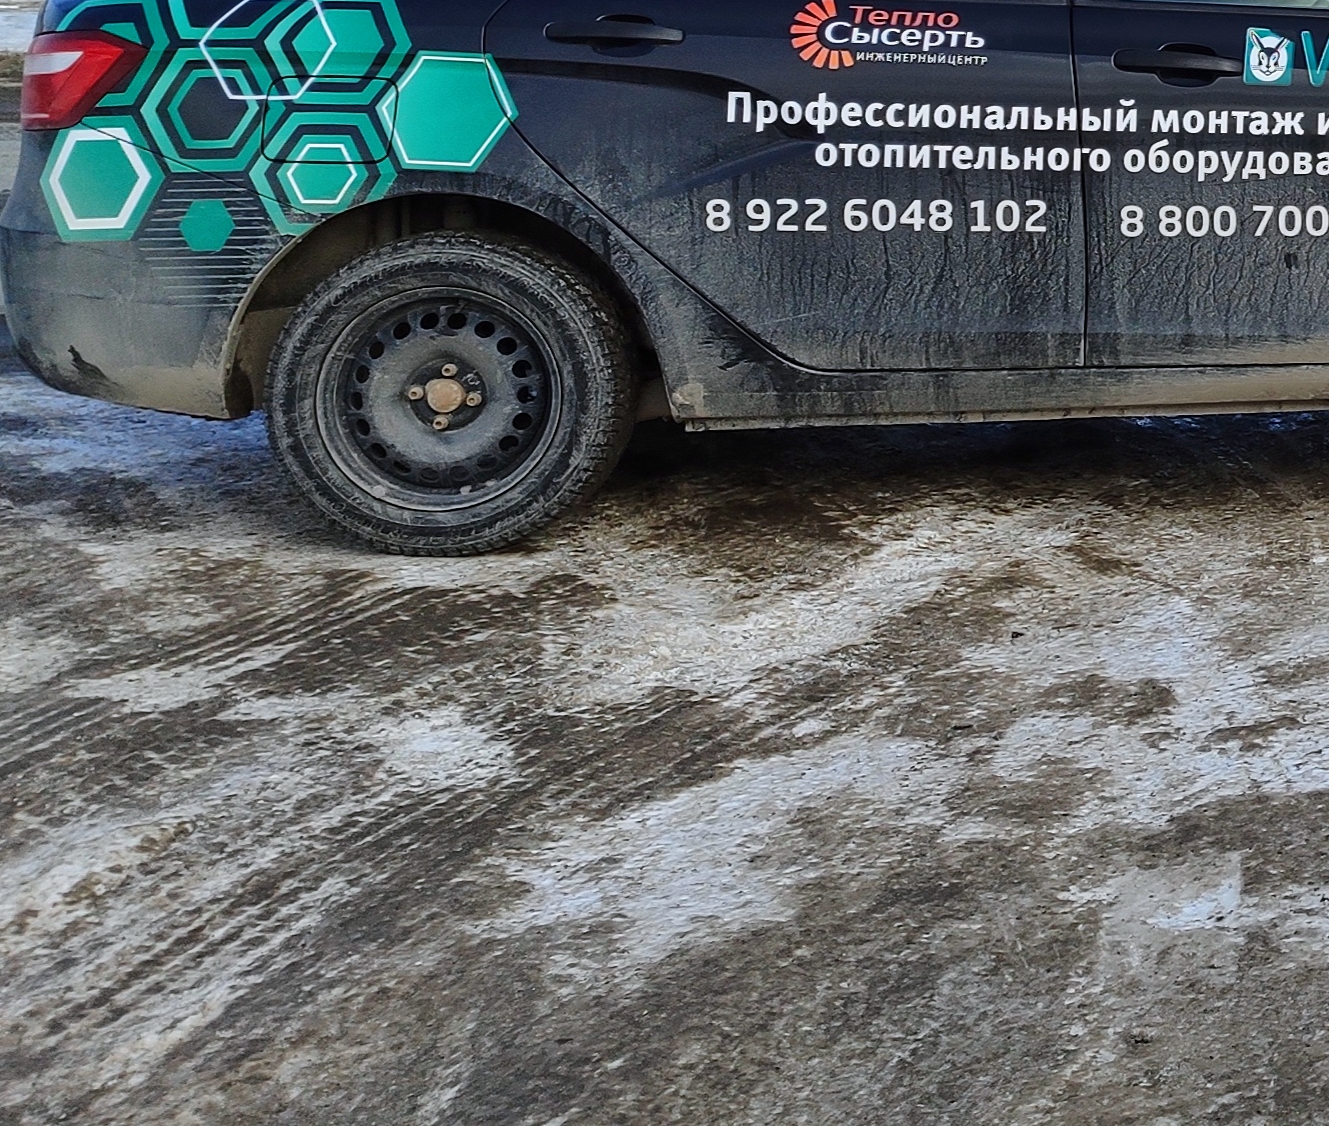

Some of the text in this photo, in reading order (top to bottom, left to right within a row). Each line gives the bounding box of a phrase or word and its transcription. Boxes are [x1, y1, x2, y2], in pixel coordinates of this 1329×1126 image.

[849, 5, 960, 28] Тепло
[824, 21, 985, 51] Сысерть
[726, 91, 1138, 134] Профессиональный
[1150, 109, 1305, 136] монтаж
[814, 142, 1112, 172] отопительного
[705, 198, 1047, 233] 8 922 6048 102
[1120, 204, 1144, 238] 8
[1158, 204, 1237, 238] 800
